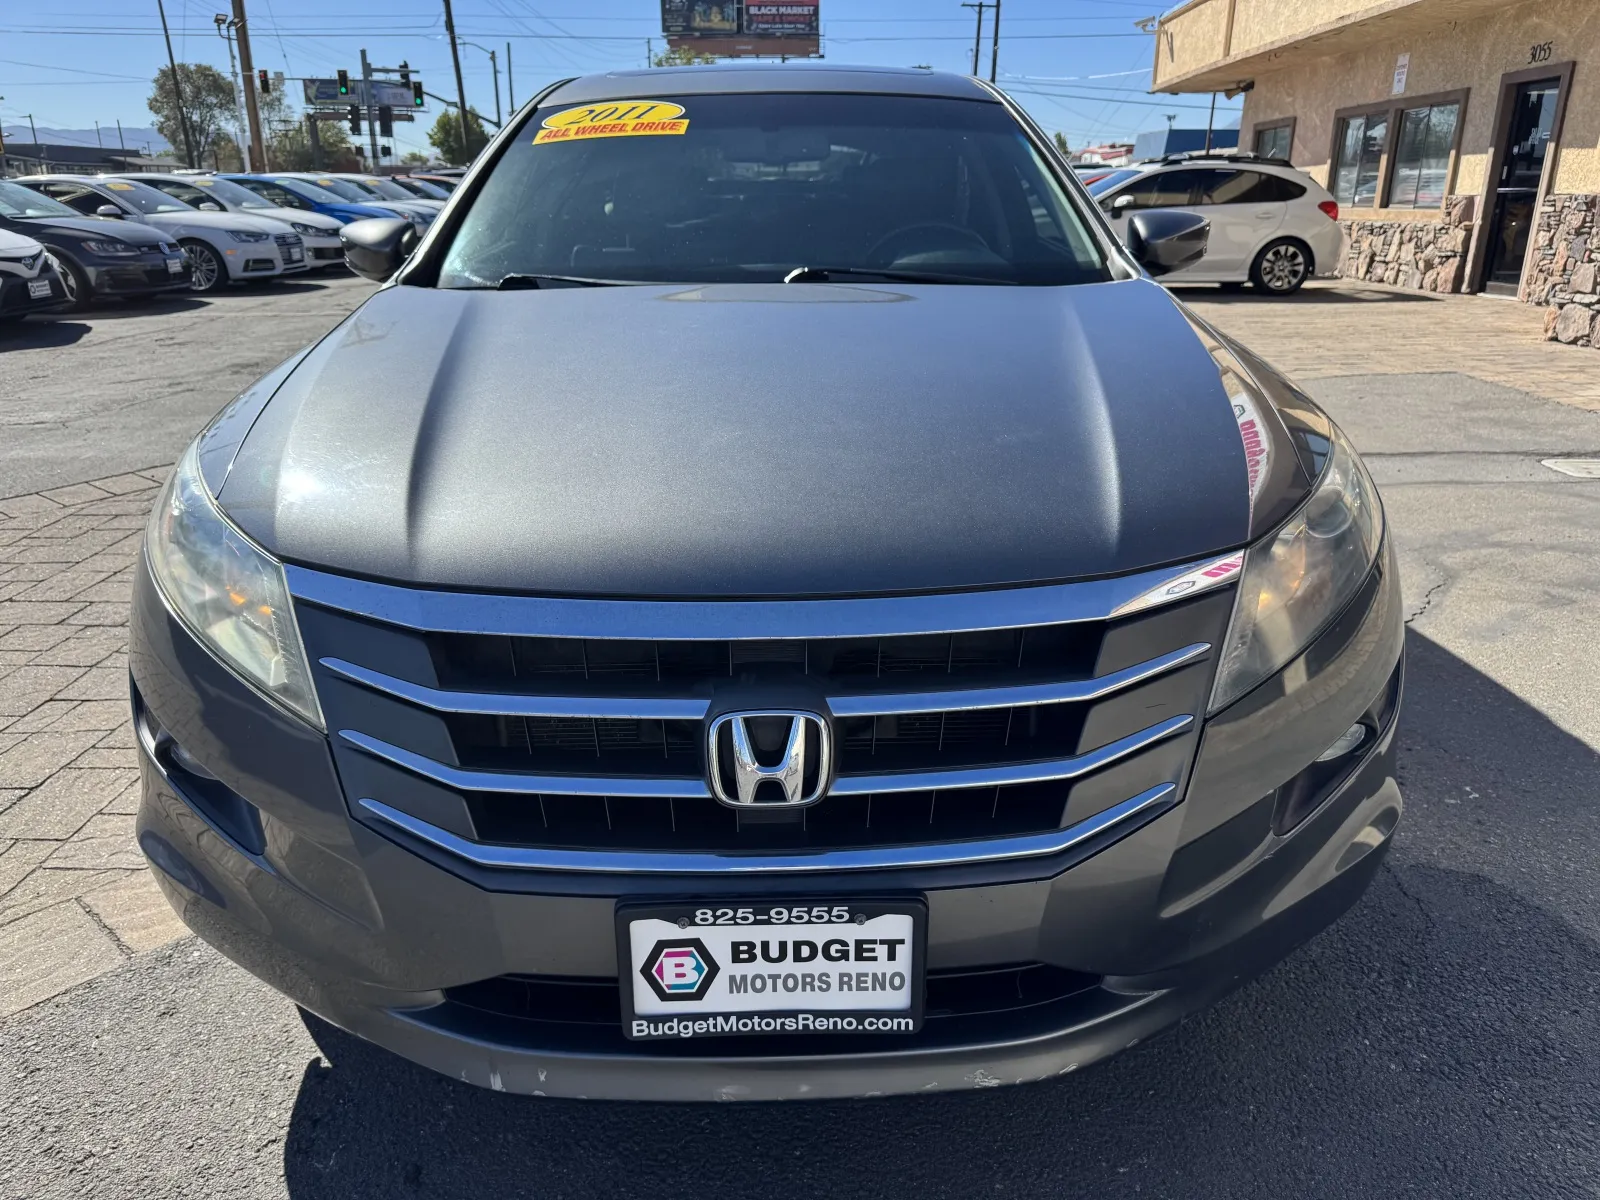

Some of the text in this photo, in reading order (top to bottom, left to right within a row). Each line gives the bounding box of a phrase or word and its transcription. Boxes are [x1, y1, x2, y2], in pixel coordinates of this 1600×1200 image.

[749, 6, 815, 14] BLACK MARKET
[1528, 40, 1553, 65] 3055
[565, 104, 660, 125] 2011
[540, 120, 685, 140] ALL WHEEL DRIVE
[694, 906, 850, 925] 825-9555
[730, 939, 906, 964] BUDGET
[728, 971, 906, 994] MOTORS RENO
[631, 1013, 914, 1038] BudgetMotorsReno.com
